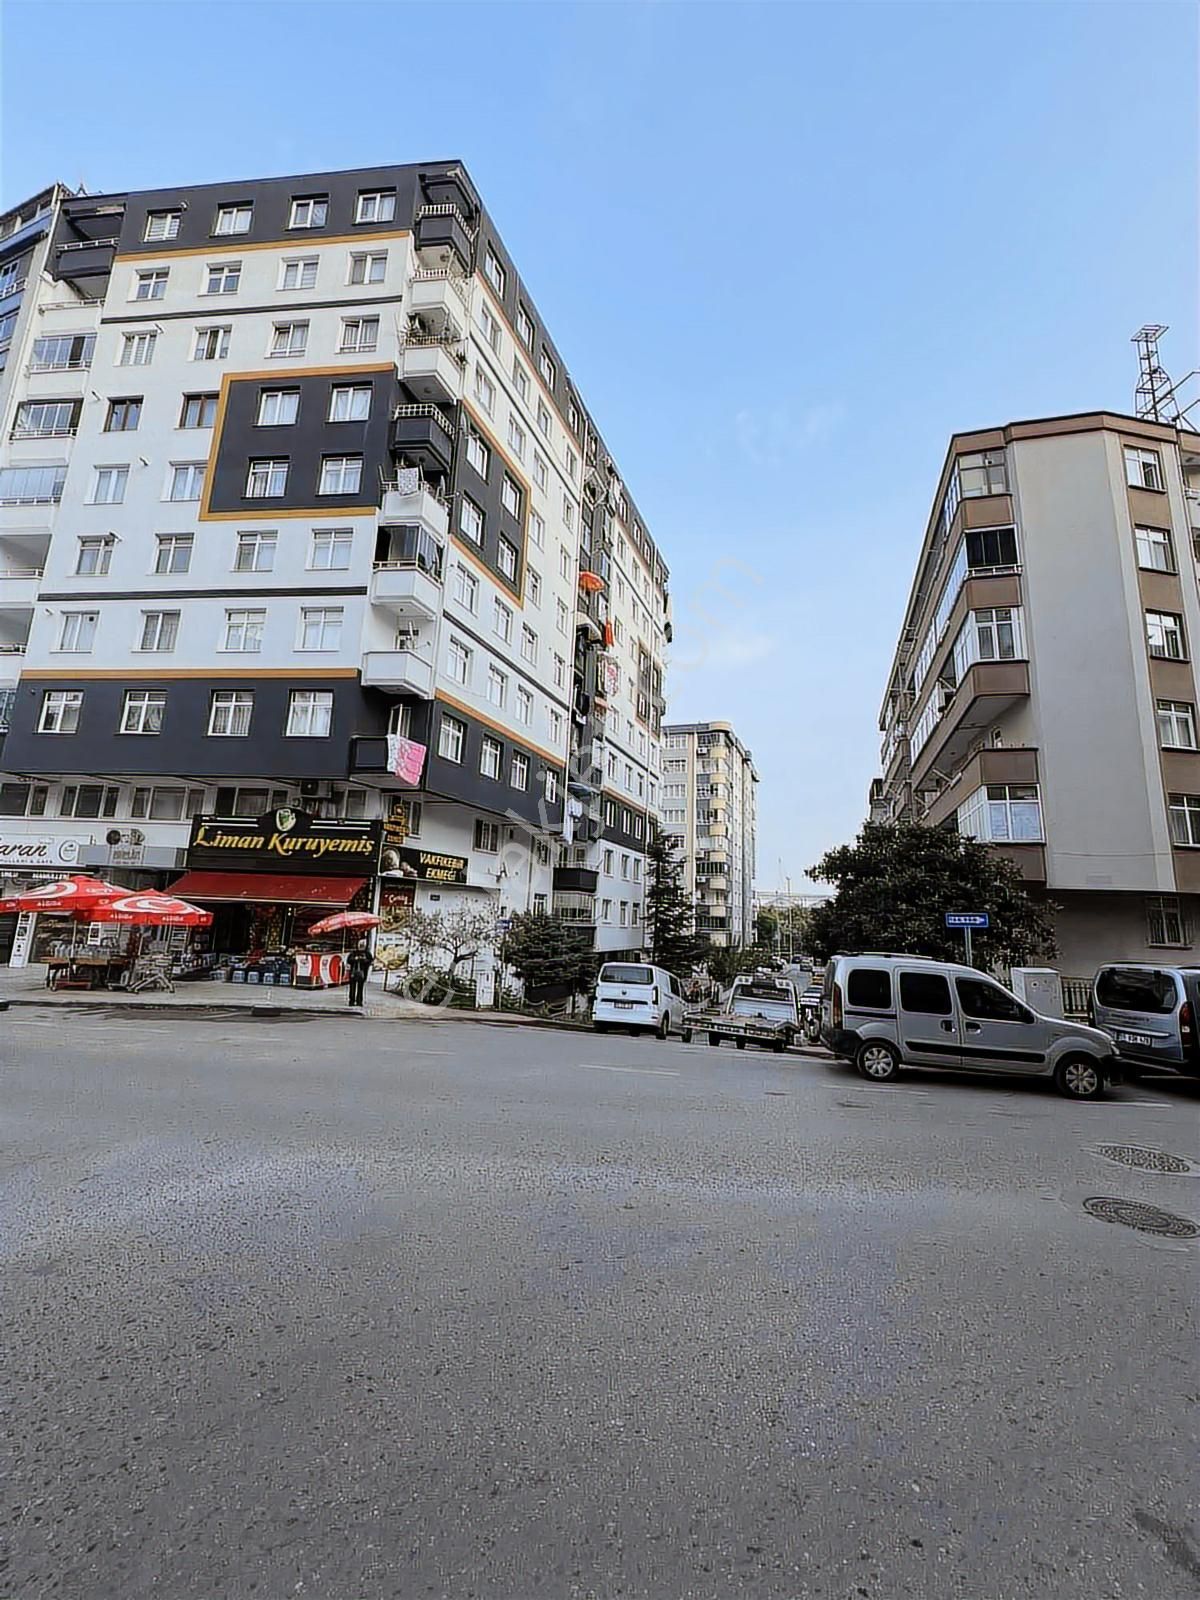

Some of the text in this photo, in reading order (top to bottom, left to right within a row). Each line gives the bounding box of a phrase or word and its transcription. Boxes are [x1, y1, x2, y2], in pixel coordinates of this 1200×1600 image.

[0, 837, 48, 856] aran
[192, 826, 265, 848] Liman
[268, 833, 376, 858] Kuruyemiş
